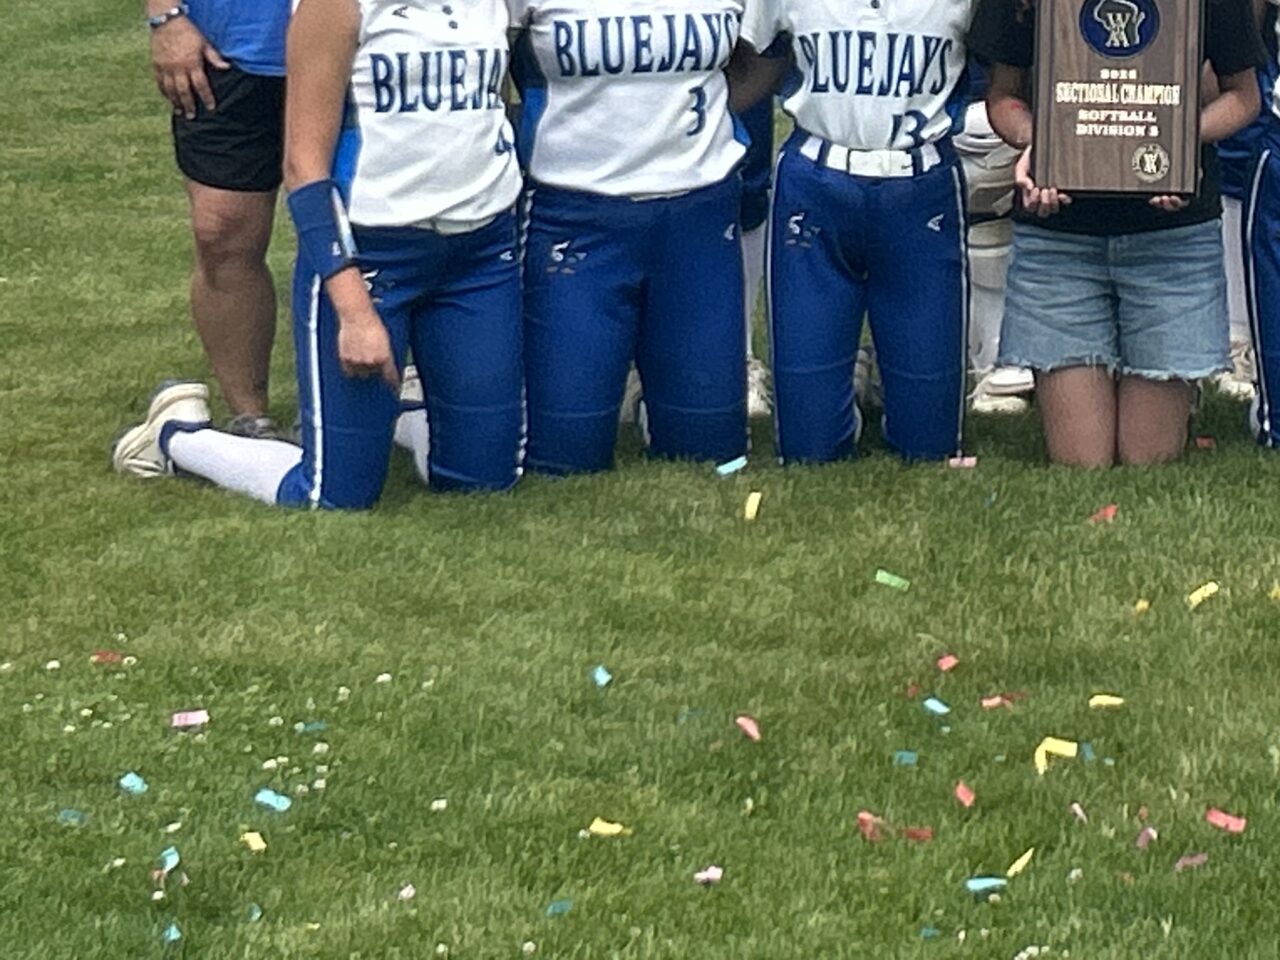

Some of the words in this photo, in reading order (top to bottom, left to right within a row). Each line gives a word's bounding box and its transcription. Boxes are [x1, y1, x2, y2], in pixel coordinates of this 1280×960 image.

[369, 48, 505, 113] BLUEJA
[1055, 82, 1119, 104] SECTIONAL
[1120, 83, 1181, 105] CHAMPION
[686, 85, 707, 136] 3
[1078, 109, 1157, 123] SOFTBALL
[1076, 123, 1147, 136] DIVISION
